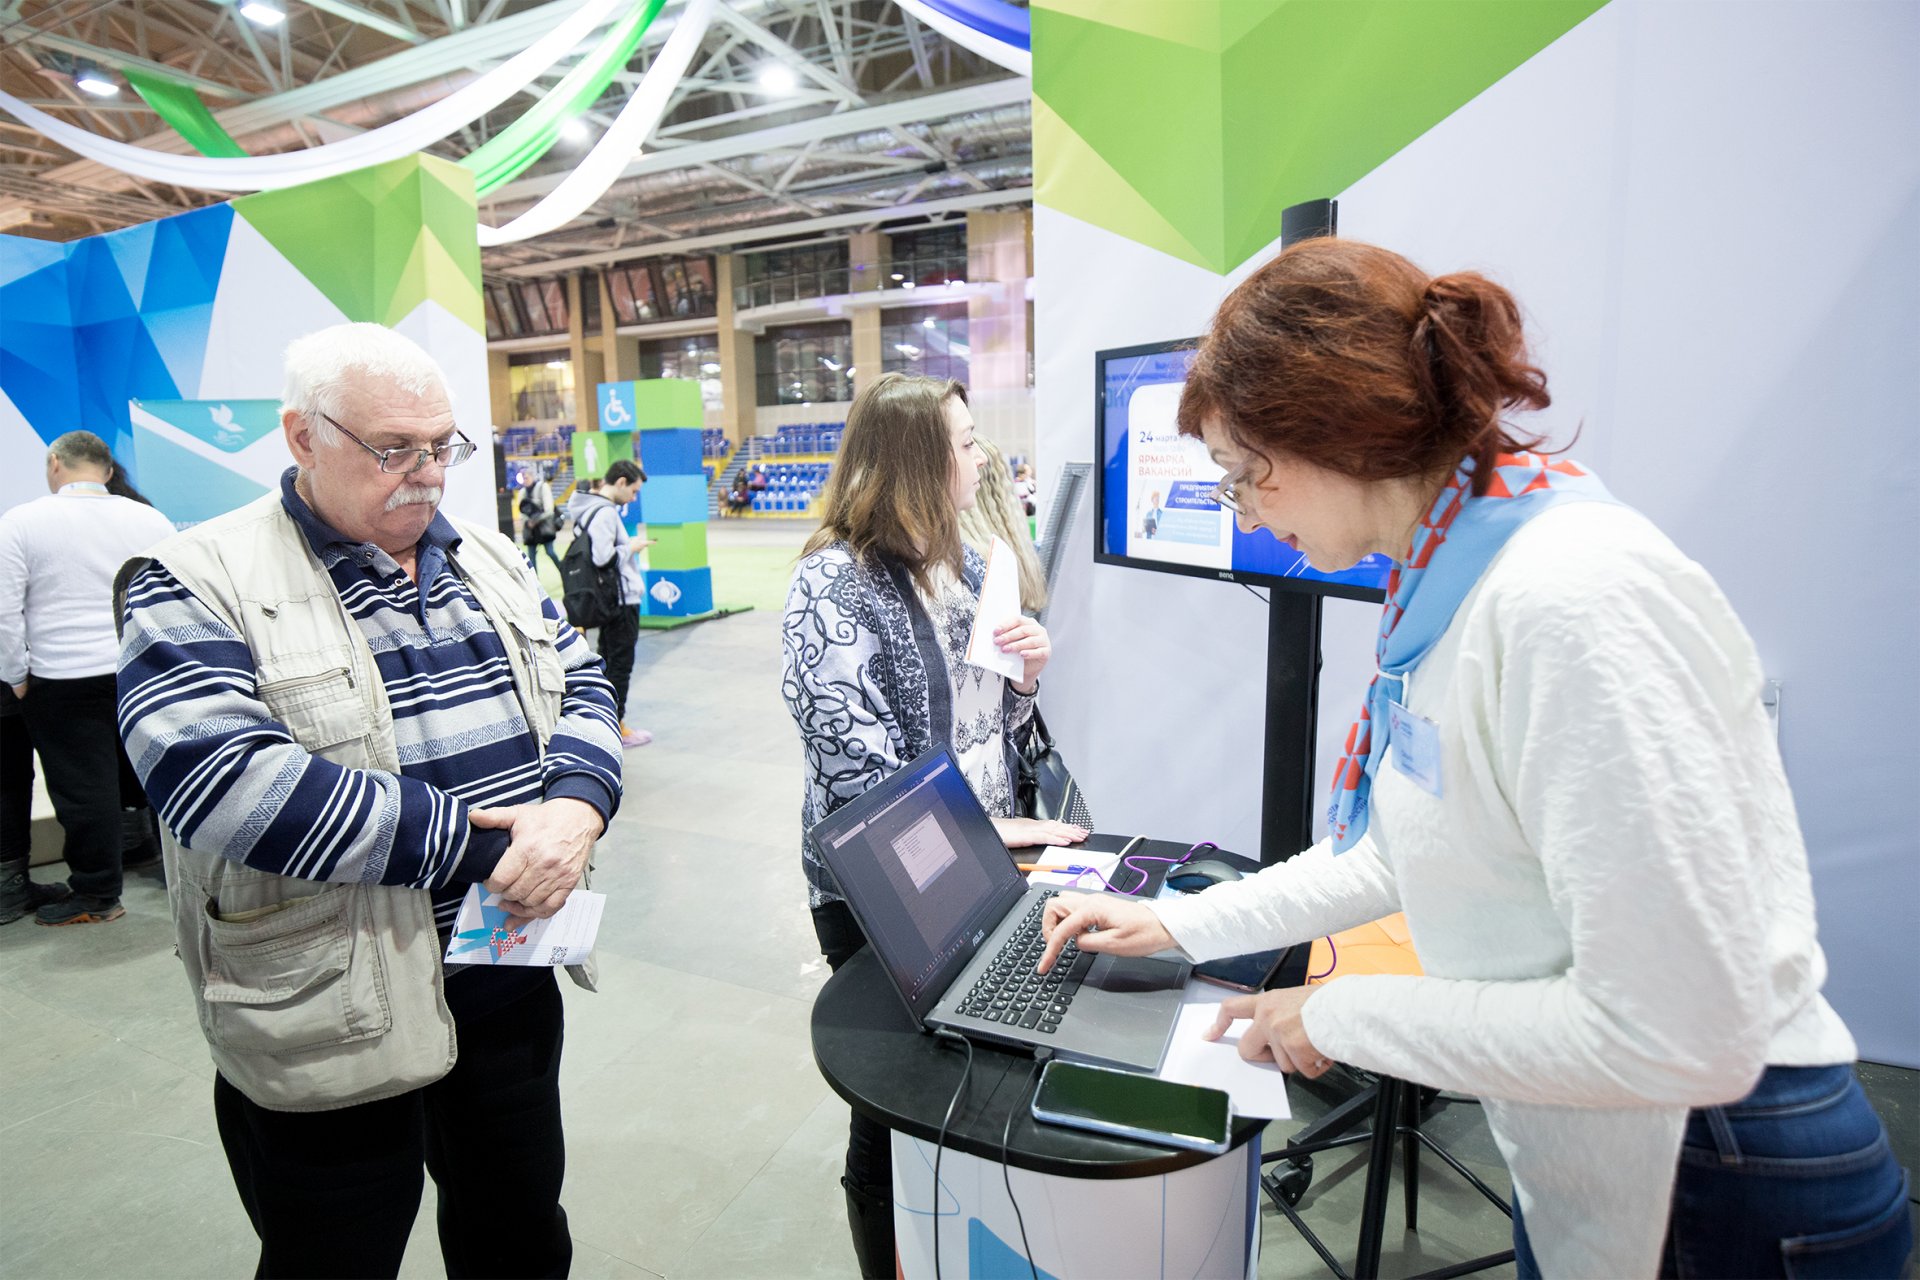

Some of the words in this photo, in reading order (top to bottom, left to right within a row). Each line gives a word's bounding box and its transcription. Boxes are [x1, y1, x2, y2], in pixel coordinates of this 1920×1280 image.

[1139, 431, 1154, 443] 24
[1138, 454, 1185, 465] ЯРМАРКА
[1138, 464, 1192, 477] ВАКАНСИЙ
[972, 929, 985, 947] ASUS
